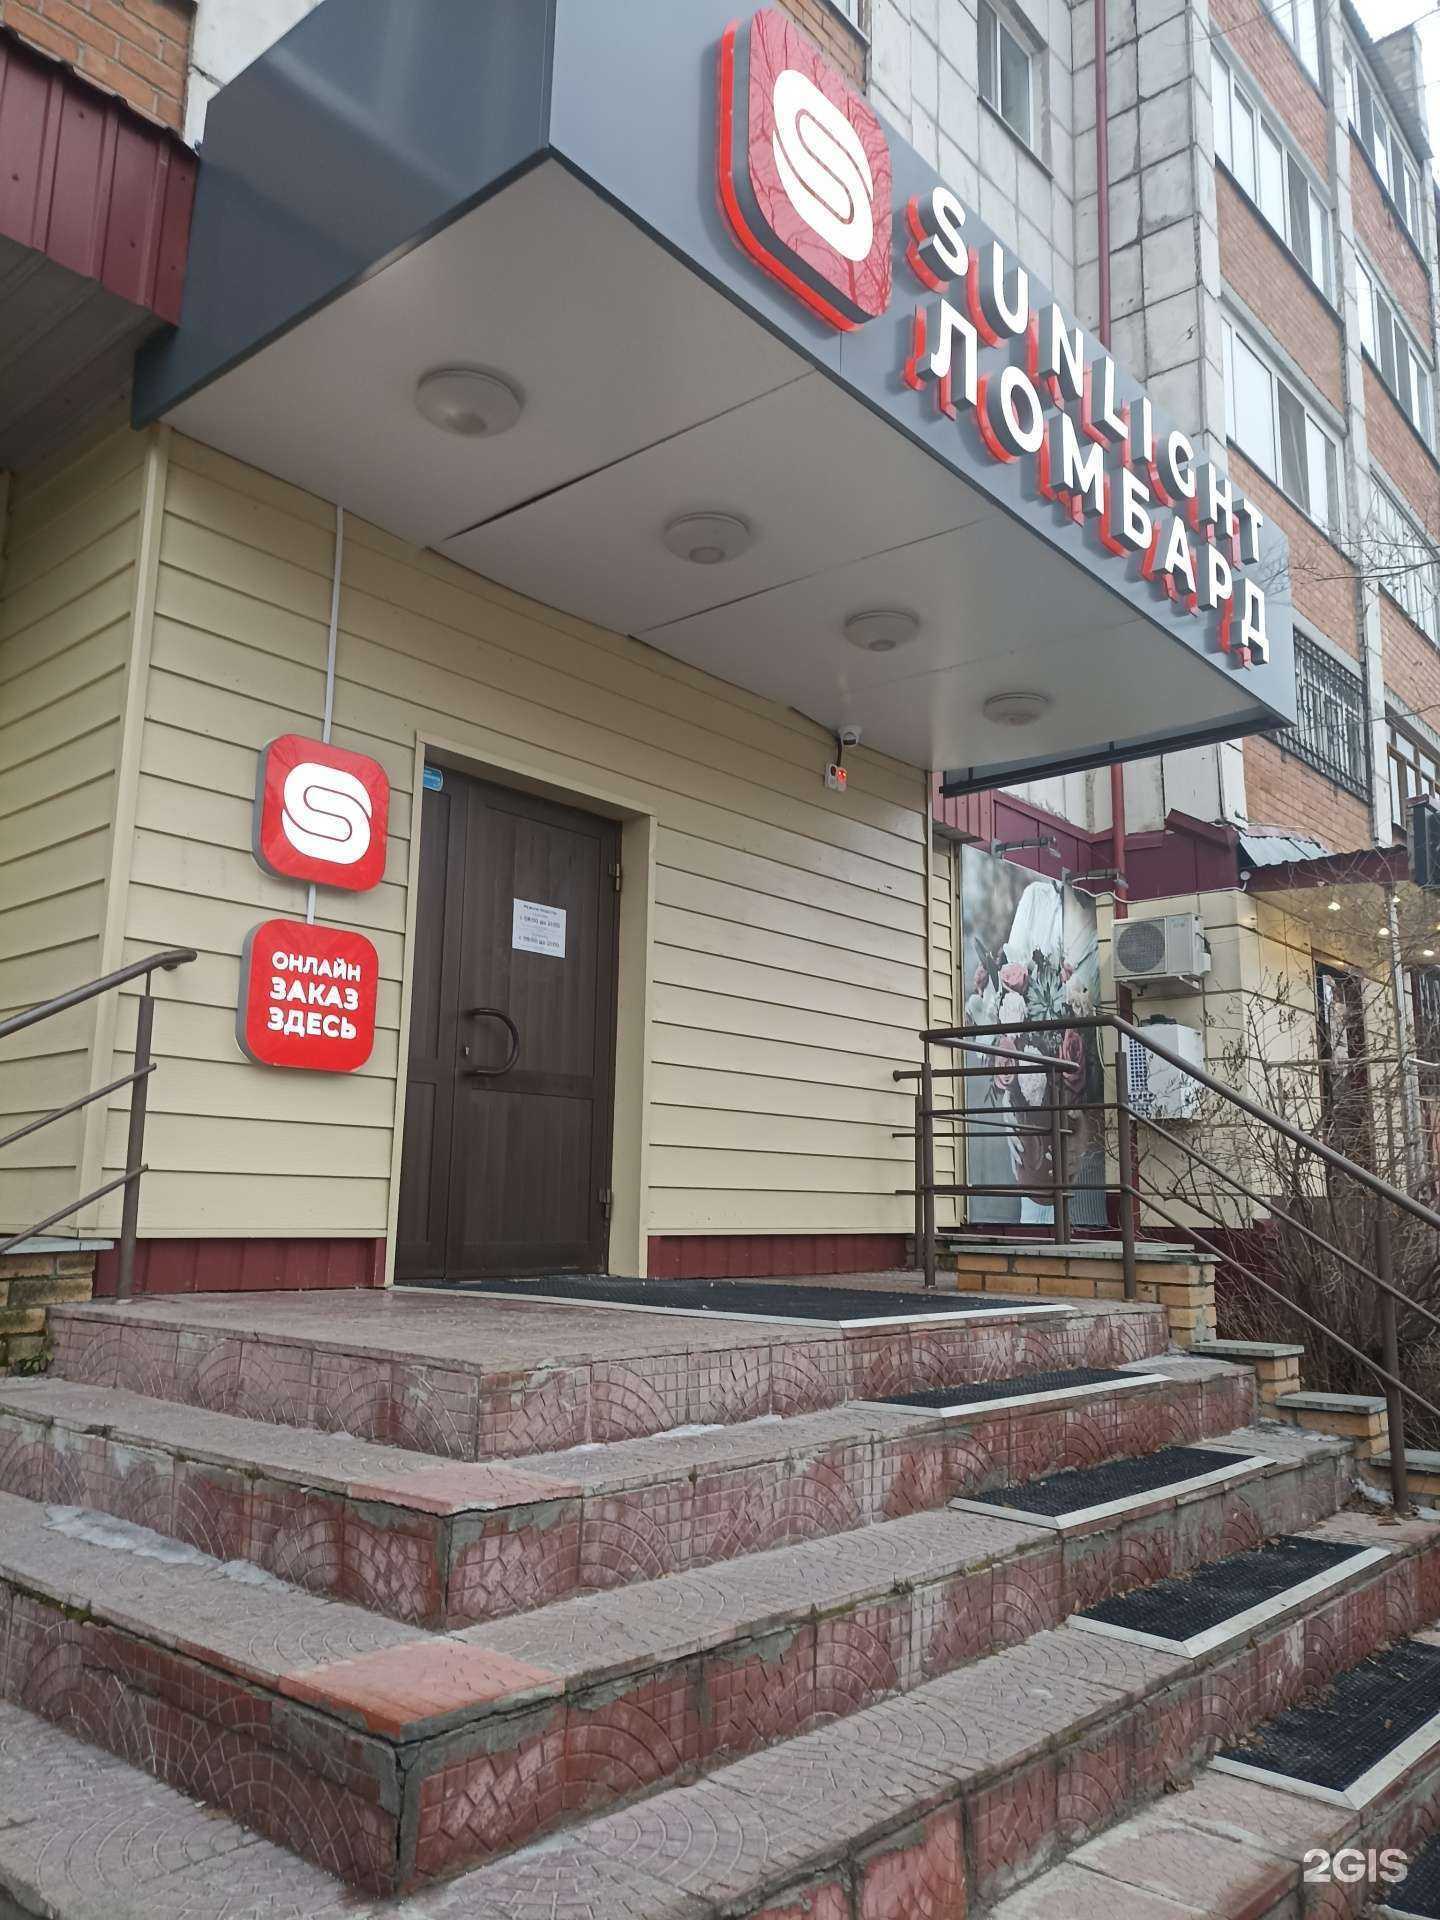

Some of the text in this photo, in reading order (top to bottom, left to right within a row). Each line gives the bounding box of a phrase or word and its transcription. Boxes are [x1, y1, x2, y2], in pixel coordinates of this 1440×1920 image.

[921, 186, 1263, 563] SUNLIGHT
[929, 298, 1270, 665] ЛОМБАРД
[271, 951, 362, 983] ОНЛАЙН
[269, 976, 359, 1011] ЗАКАЗ
[267, 1006, 358, 1040] ЗДЕСЬ
